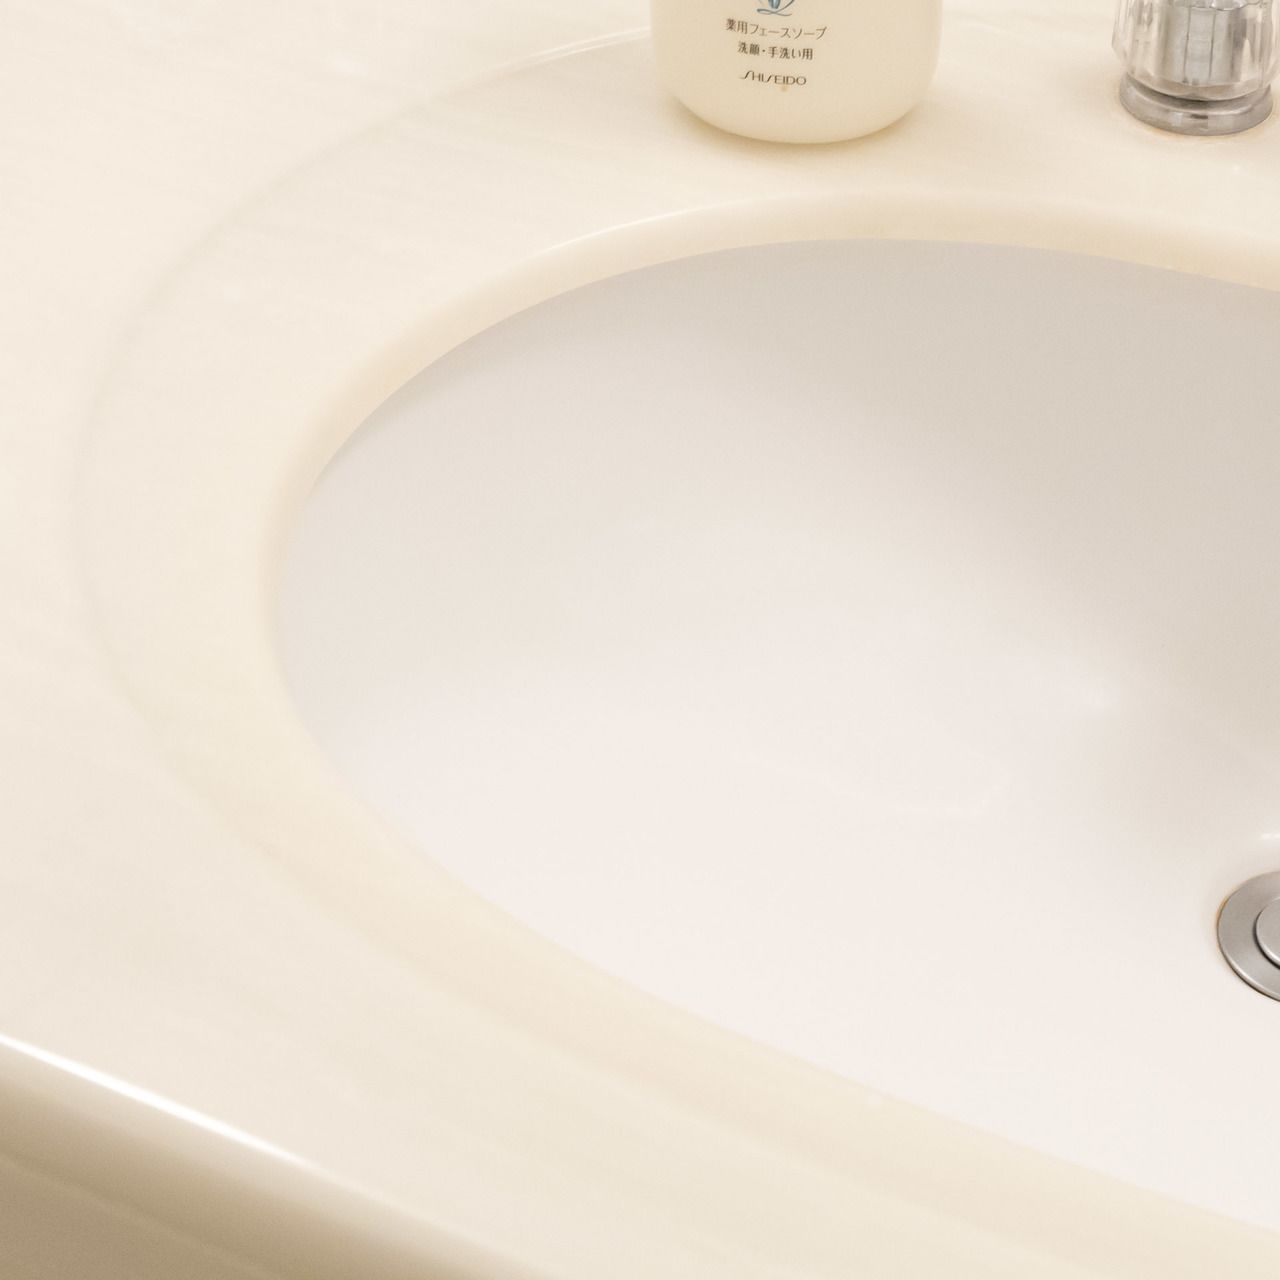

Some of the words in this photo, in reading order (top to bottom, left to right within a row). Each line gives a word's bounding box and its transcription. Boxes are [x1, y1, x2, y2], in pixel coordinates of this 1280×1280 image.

[725, 18, 828, 41] 薬用フェースソープ
[737, 41, 814, 61] 洗顔・手洗い用
[738, 70, 807, 86] SHISEIDO
